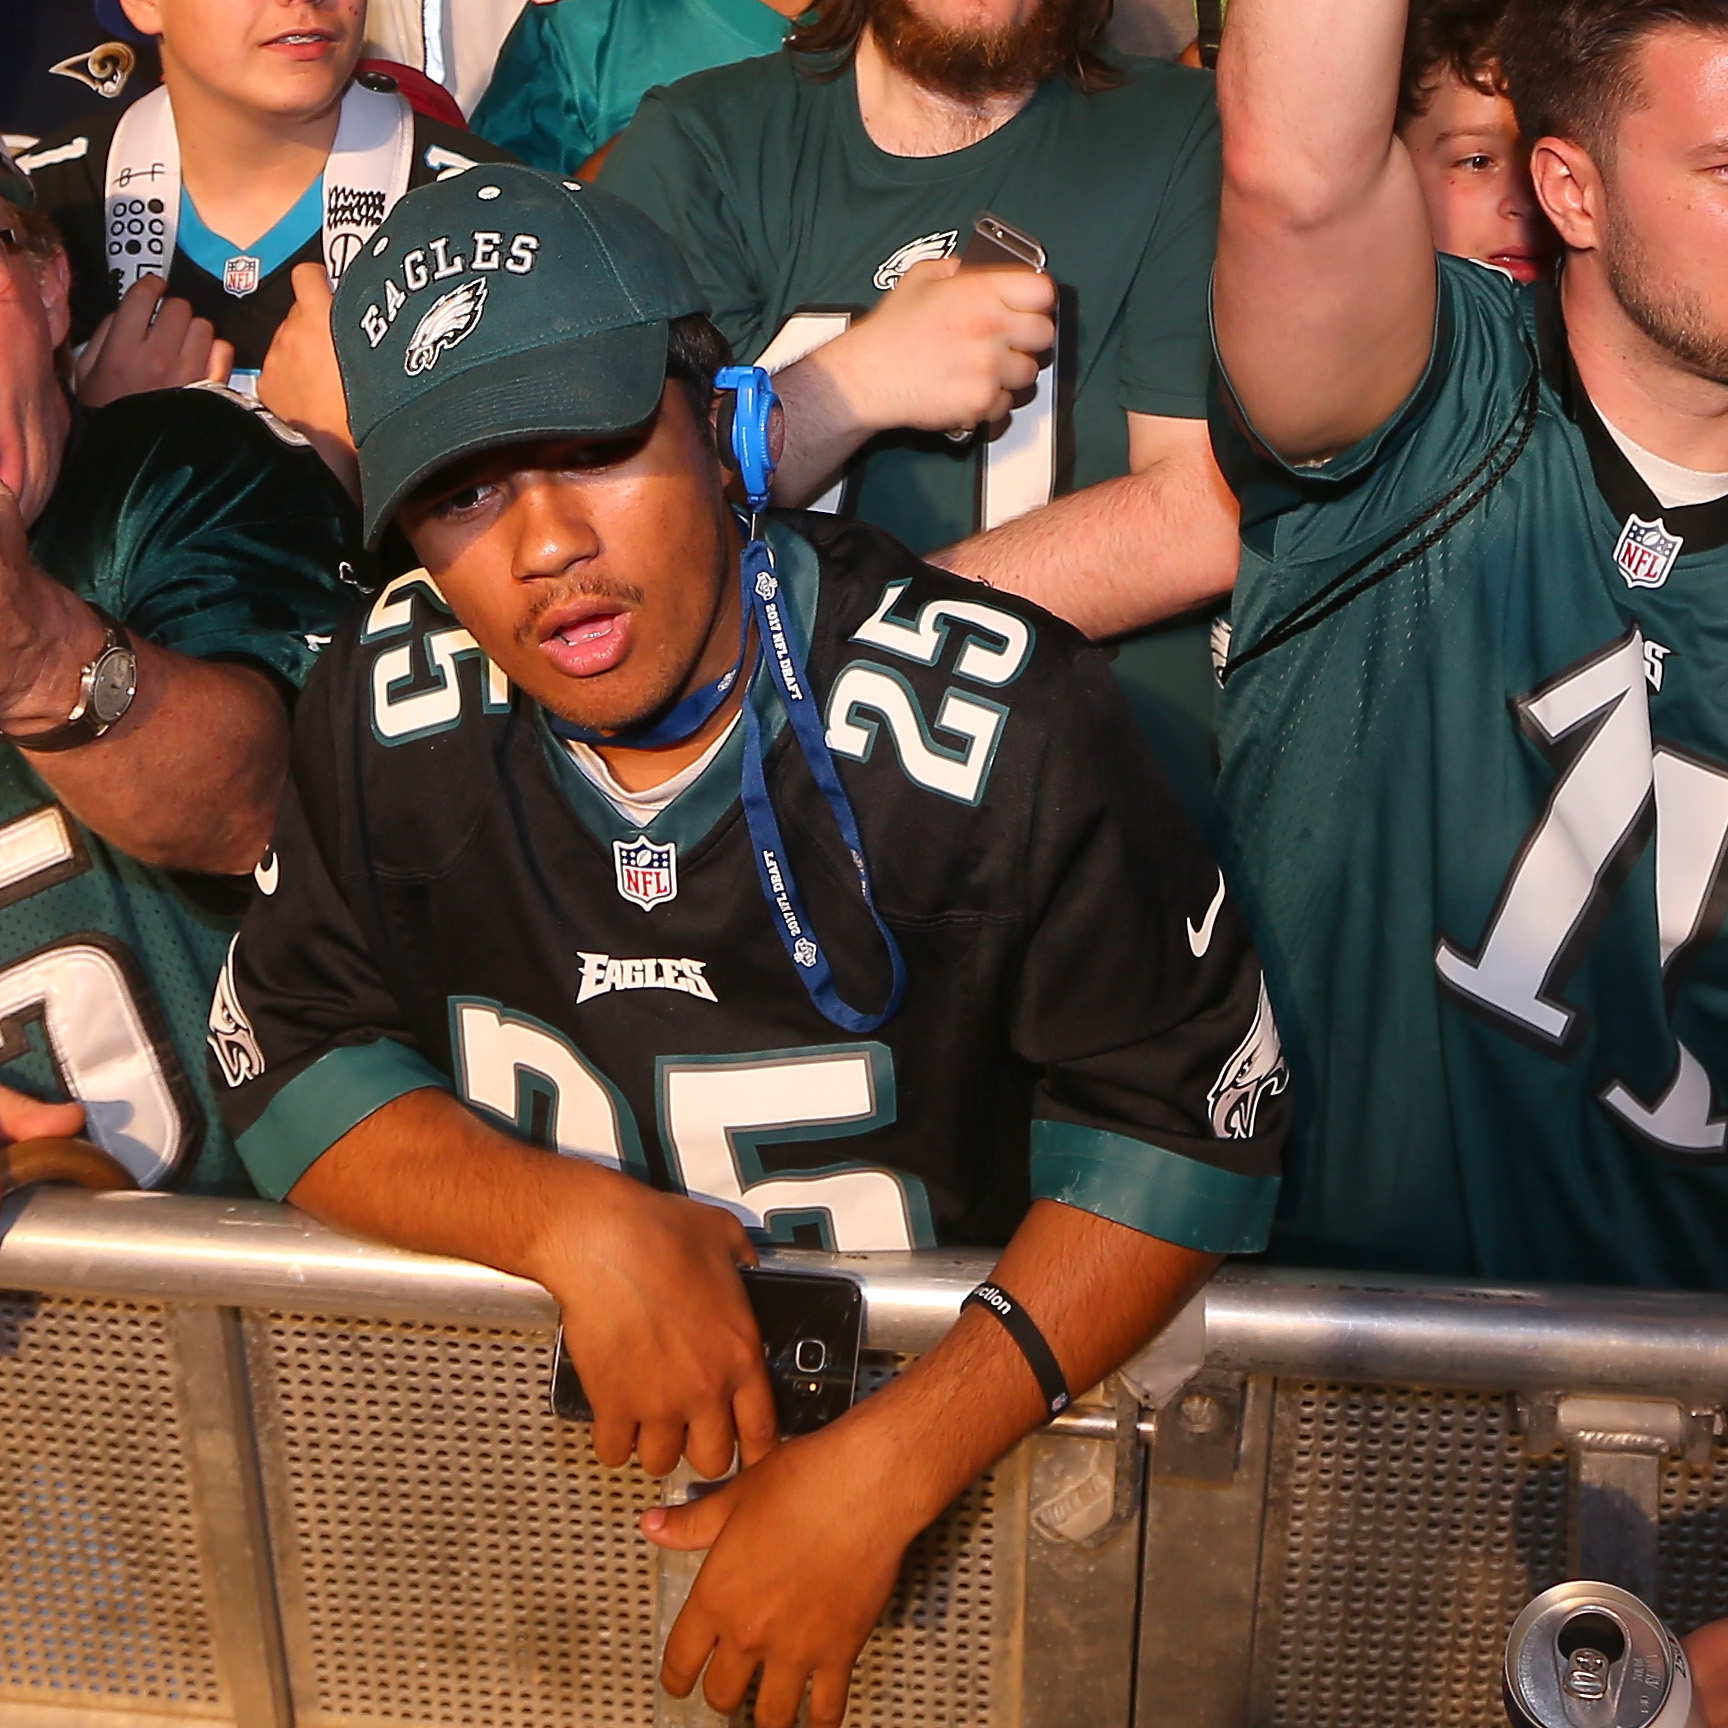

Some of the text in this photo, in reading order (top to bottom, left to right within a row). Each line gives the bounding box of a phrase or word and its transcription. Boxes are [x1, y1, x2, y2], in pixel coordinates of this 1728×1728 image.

[227, 272, 254, 289] NFL
[358, 230, 541, 349] EAGLES
[1620, 541, 1660, 579] NFL
[764, 602, 783, 632] 2017
[771, 631, 790, 661] NFL
[778, 656, 805, 702] DRAFT
[824, 576, 1037, 807] 25
[625, 868, 668, 898] NFL
[761, 848, 786, 894] DRAFT
[781, 911, 803, 938] 2017
[575, 949, 720, 1005] EAGLES
